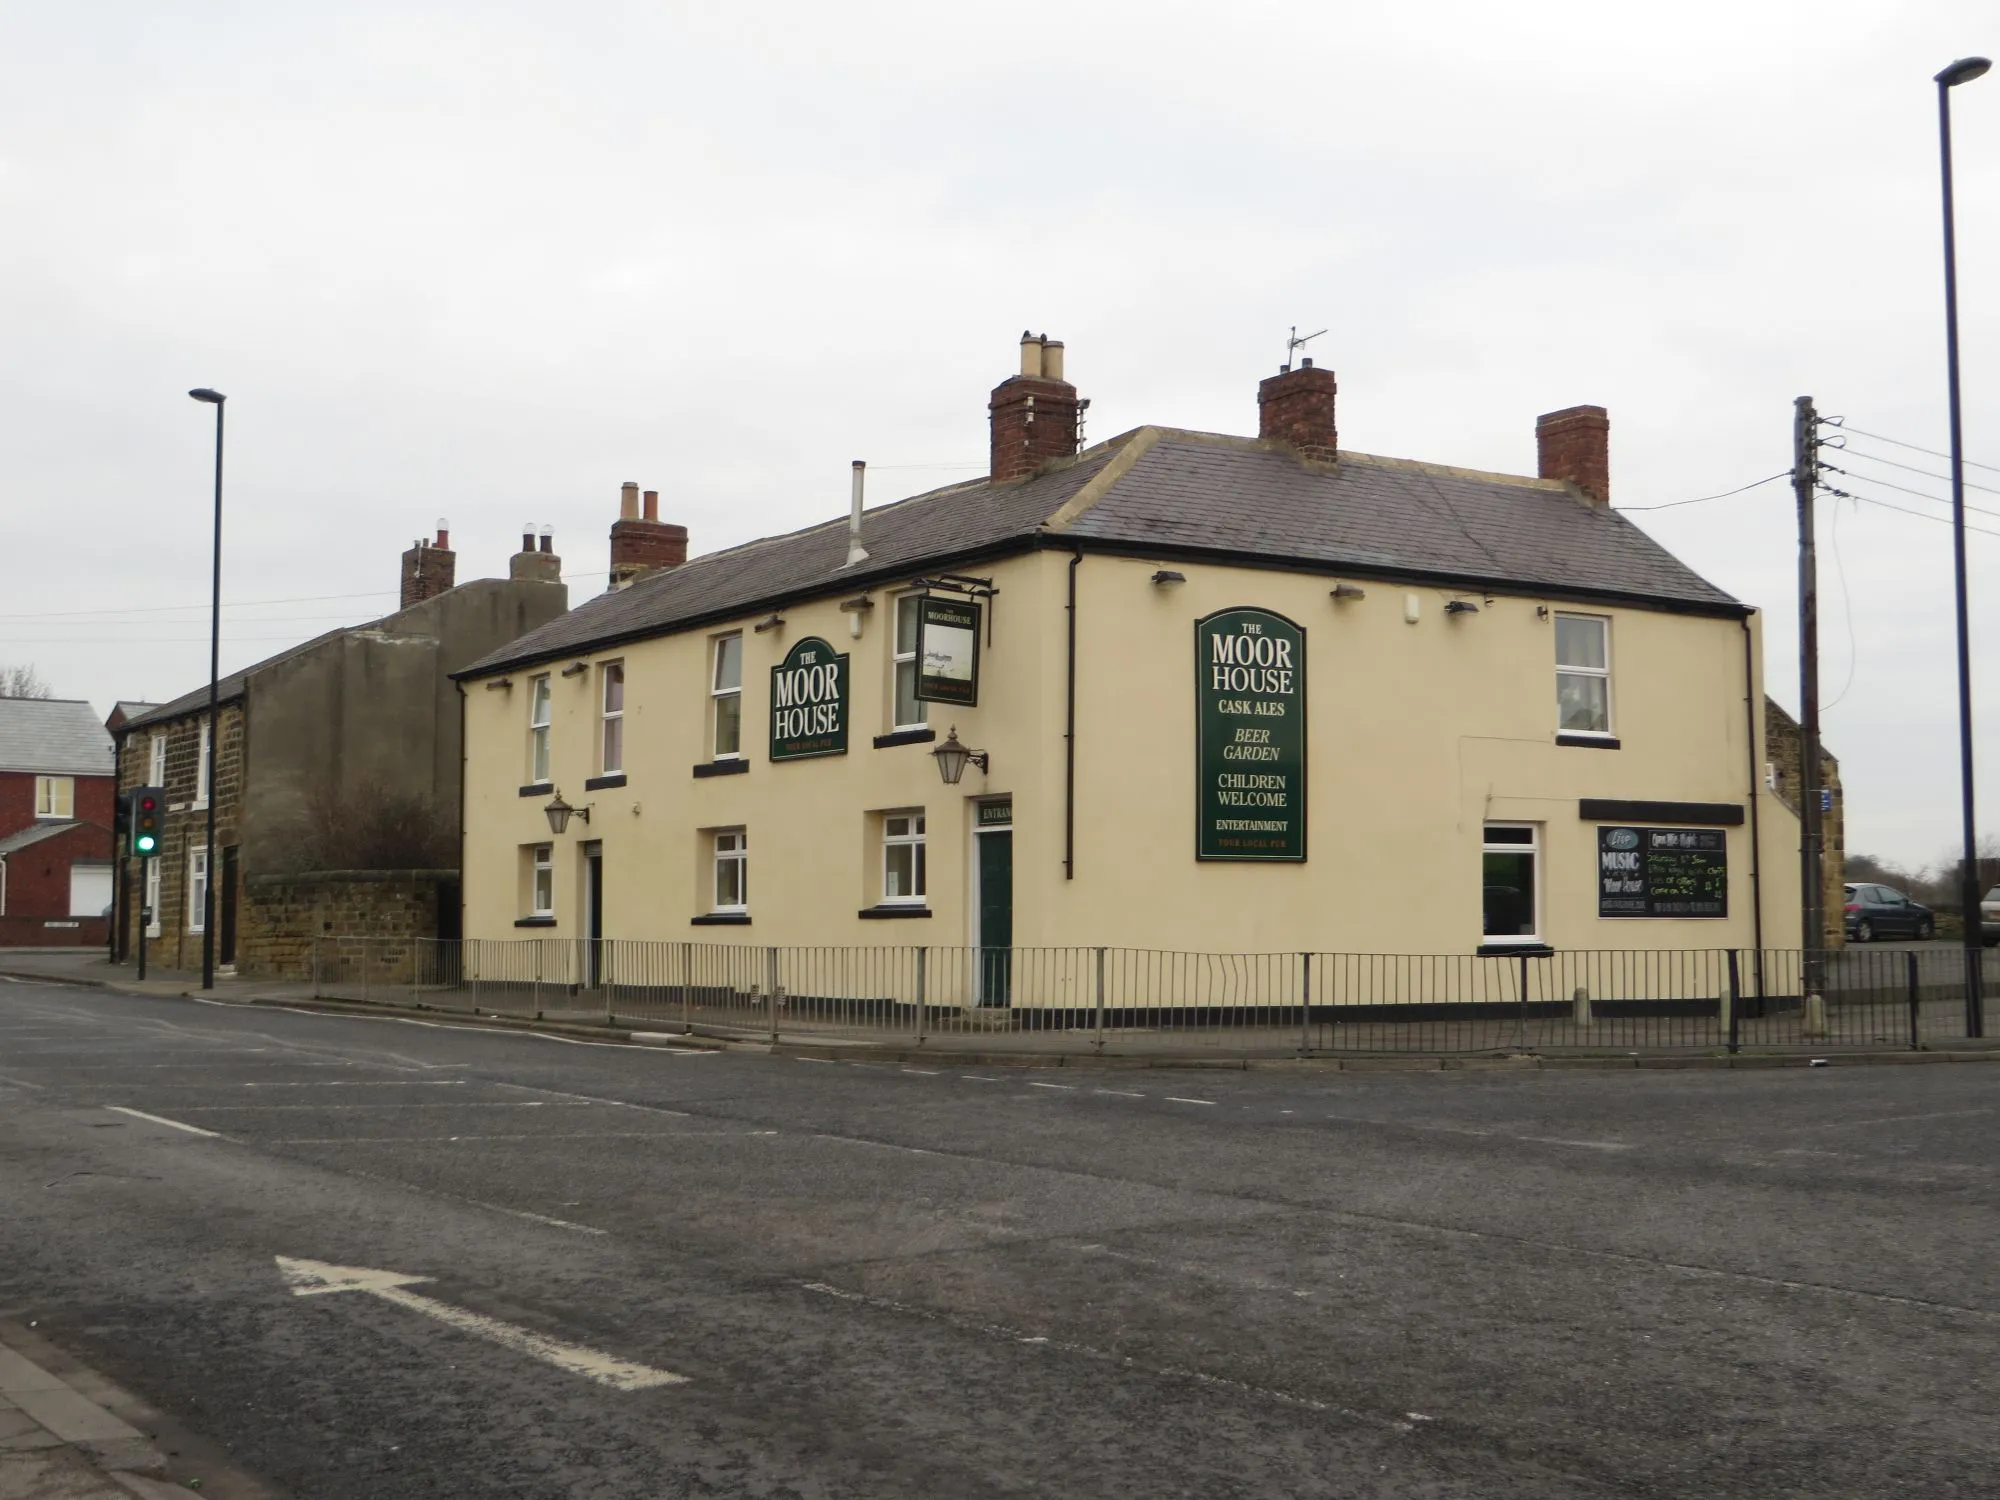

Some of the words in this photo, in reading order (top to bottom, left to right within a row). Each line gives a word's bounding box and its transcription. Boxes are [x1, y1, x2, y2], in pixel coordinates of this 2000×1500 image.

[928, 611, 972, 624] MOORHOUSE
[1241, 623, 1262, 635] THE
[800, 651, 816, 665] THE
[1211, 633, 1293, 668] MOOR
[776, 663, 840, 708] MOOR
[1212, 666, 1294, 694] HOUSE
[1218, 699, 1252, 715] CASK
[1254, 701, 1285, 716] ALES
[775, 702, 840, 740] HOUSE
[1234, 728, 1271, 744] BEER
[1223, 745, 1281, 761] GARDEN
[1217, 773, 1286, 789] CHILDREN
[1217, 791, 1287, 807] WELCOME
[1216, 819, 1288, 832] ENTERTAINMENT
[1602, 852, 1640, 870] MUSIC
